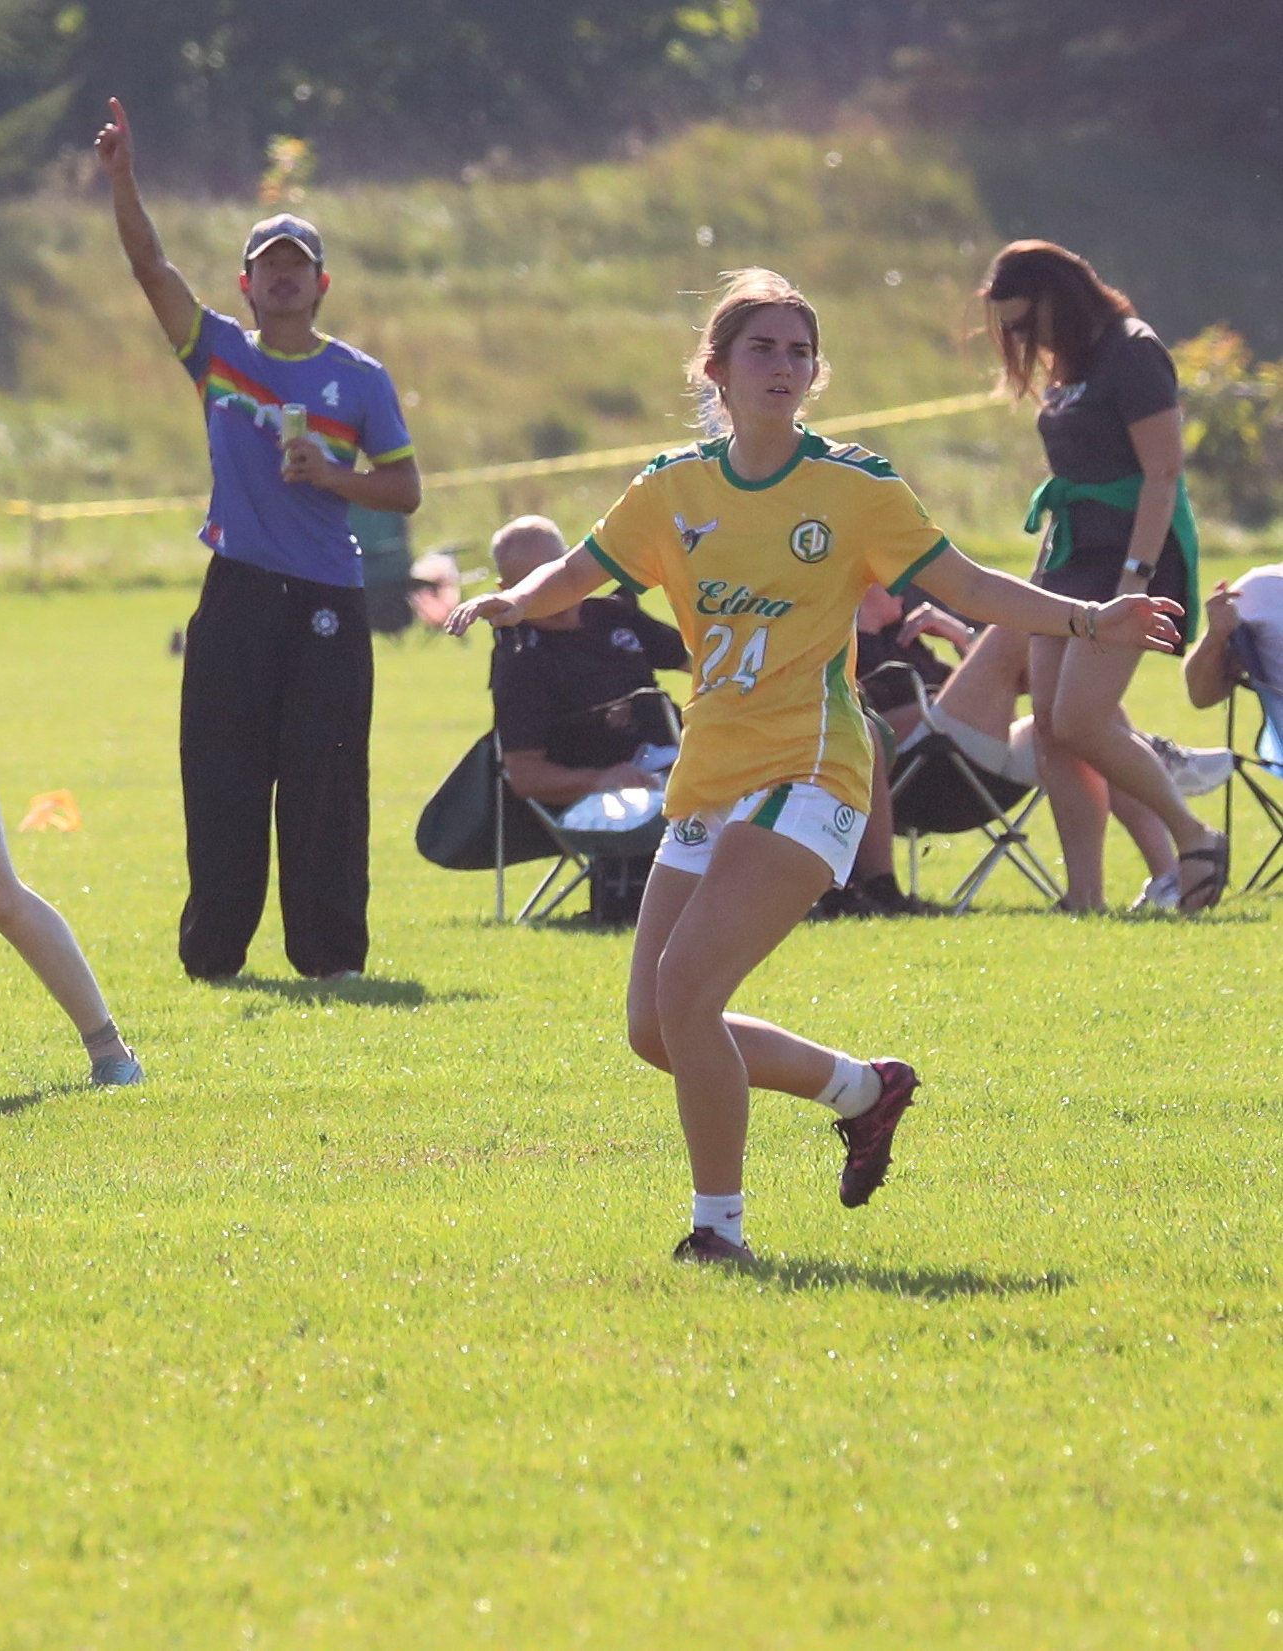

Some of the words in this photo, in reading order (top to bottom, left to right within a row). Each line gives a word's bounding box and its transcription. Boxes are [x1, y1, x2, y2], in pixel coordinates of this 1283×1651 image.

[321, 380, 341, 407] 4
[696, 580, 794, 618] Edina
[697, 624, 769, 696] 24
